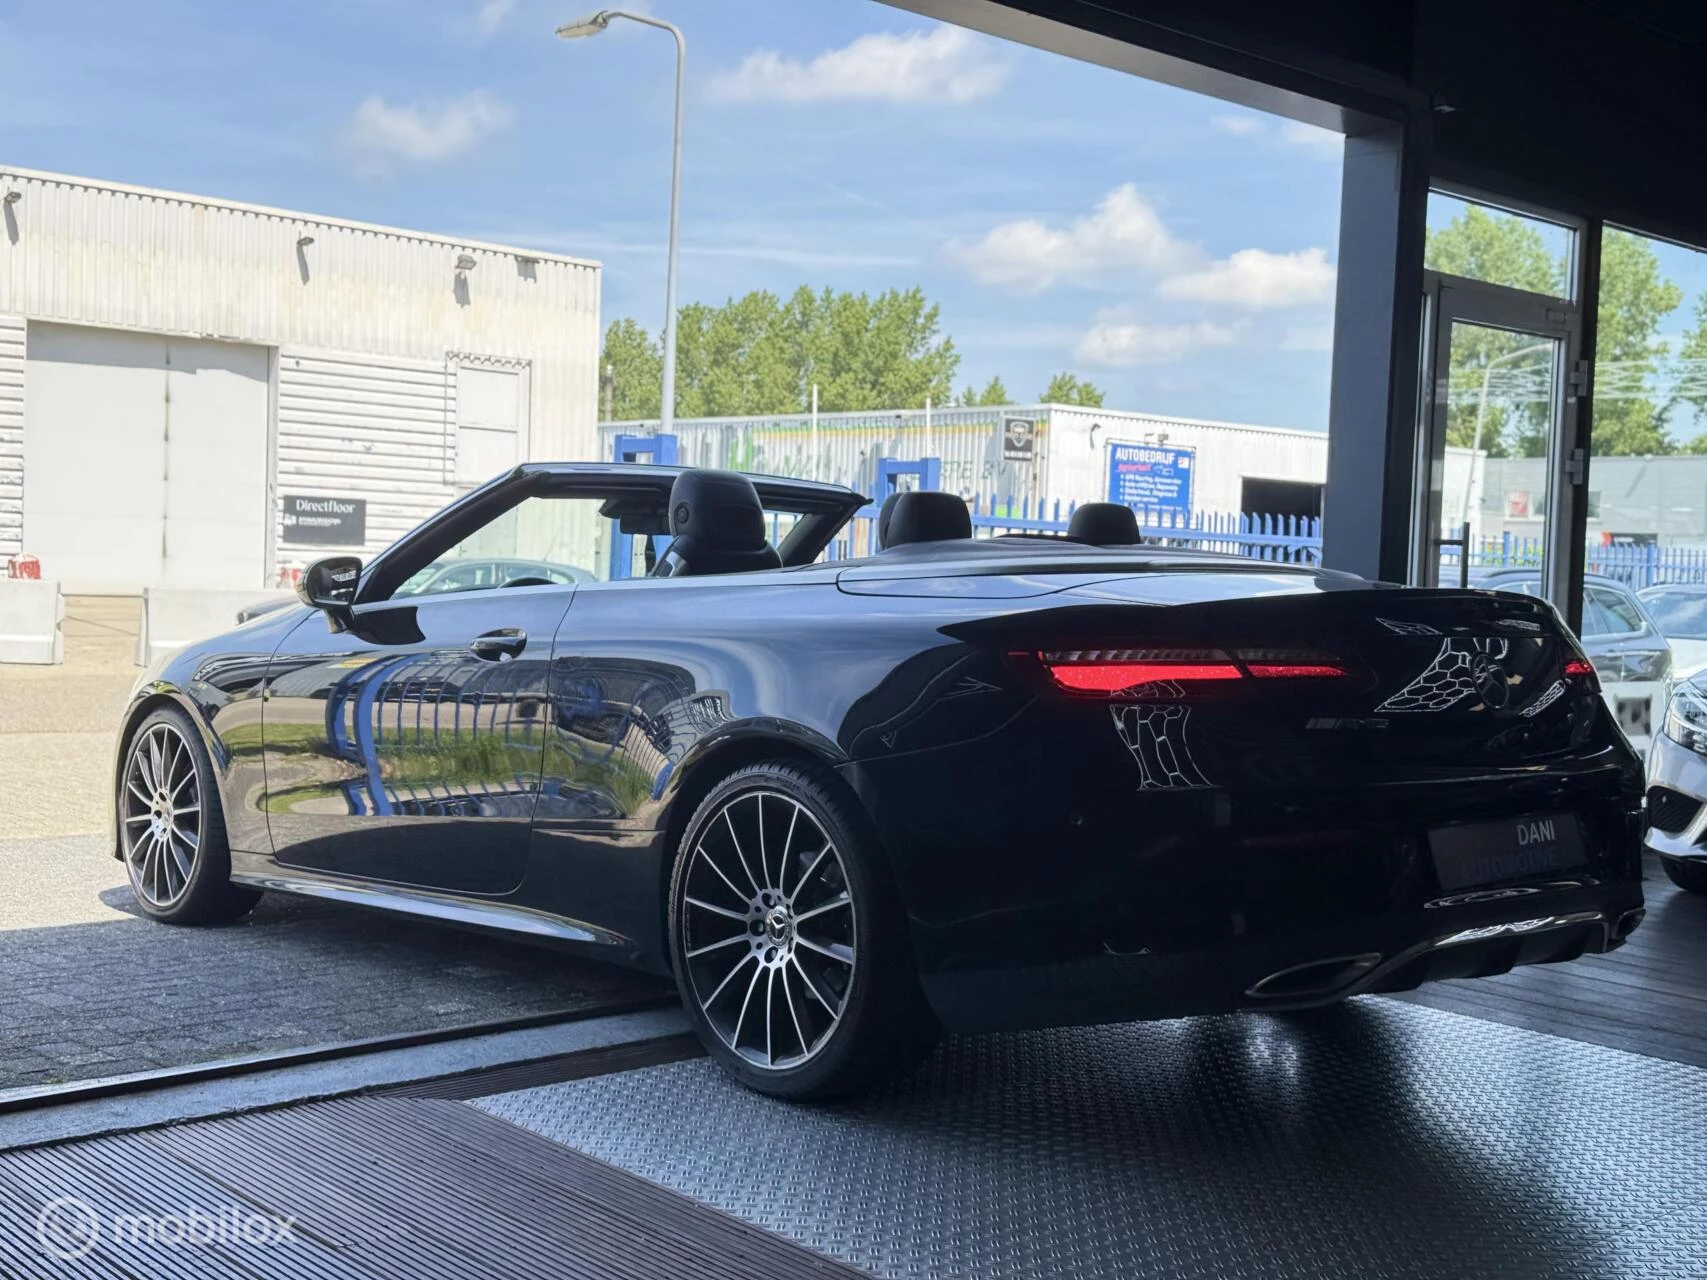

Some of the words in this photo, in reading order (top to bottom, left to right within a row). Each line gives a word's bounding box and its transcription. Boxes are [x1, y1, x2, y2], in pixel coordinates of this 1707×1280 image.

[1115, 447, 1176, 464] AUTOBEDRIJF
[296, 499, 355, 513] Directfloor
[1516, 820, 1555, 845] DANI
[1460, 847, 1559, 881] AUTOMOTIVE
